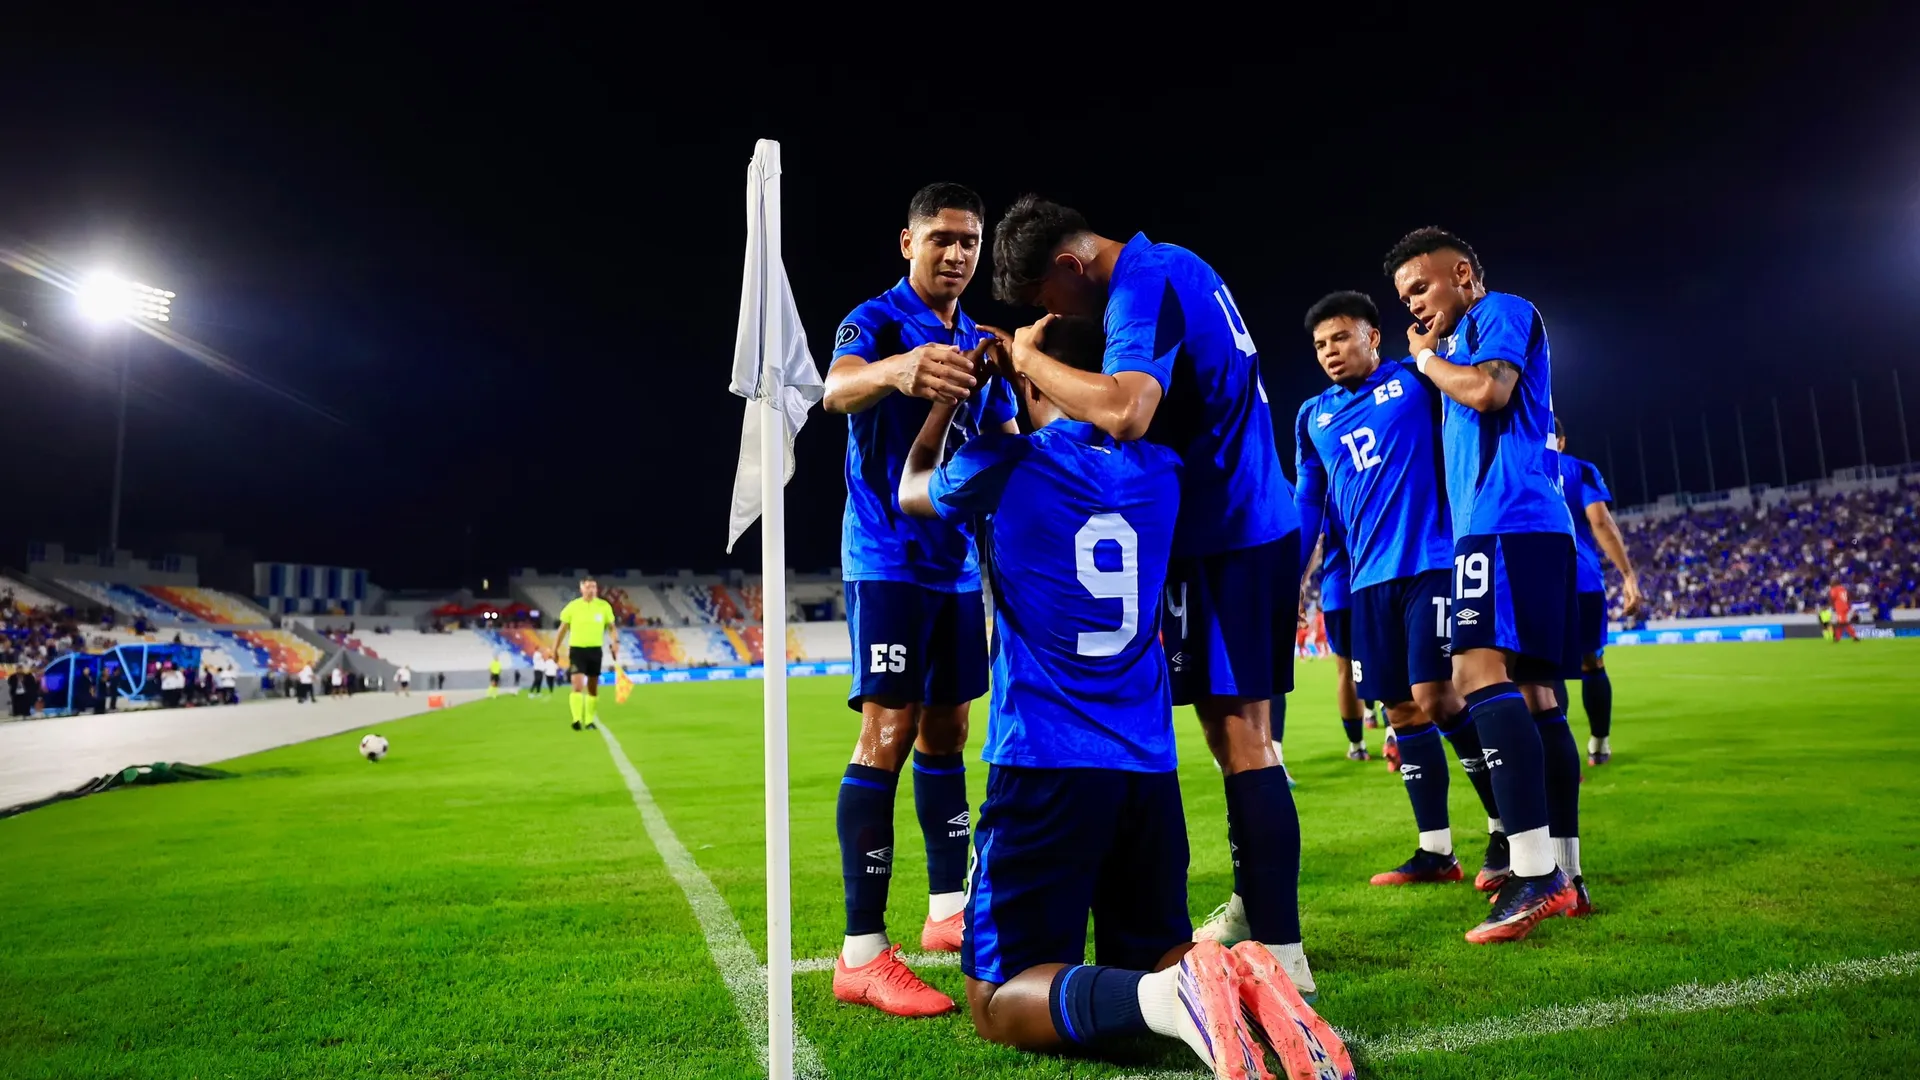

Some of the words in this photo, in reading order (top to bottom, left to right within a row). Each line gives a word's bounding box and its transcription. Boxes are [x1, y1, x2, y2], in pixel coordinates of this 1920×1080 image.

[1373, 378, 1404, 405] ES
[1339, 426, 1383, 473] 12
[1074, 513, 1139, 657] 9
[1454, 552, 1490, 599] 19
[1166, 581, 1188, 640] 4
[1457, 618, 1478, 626] umbro
[869, 644, 907, 673] ES
